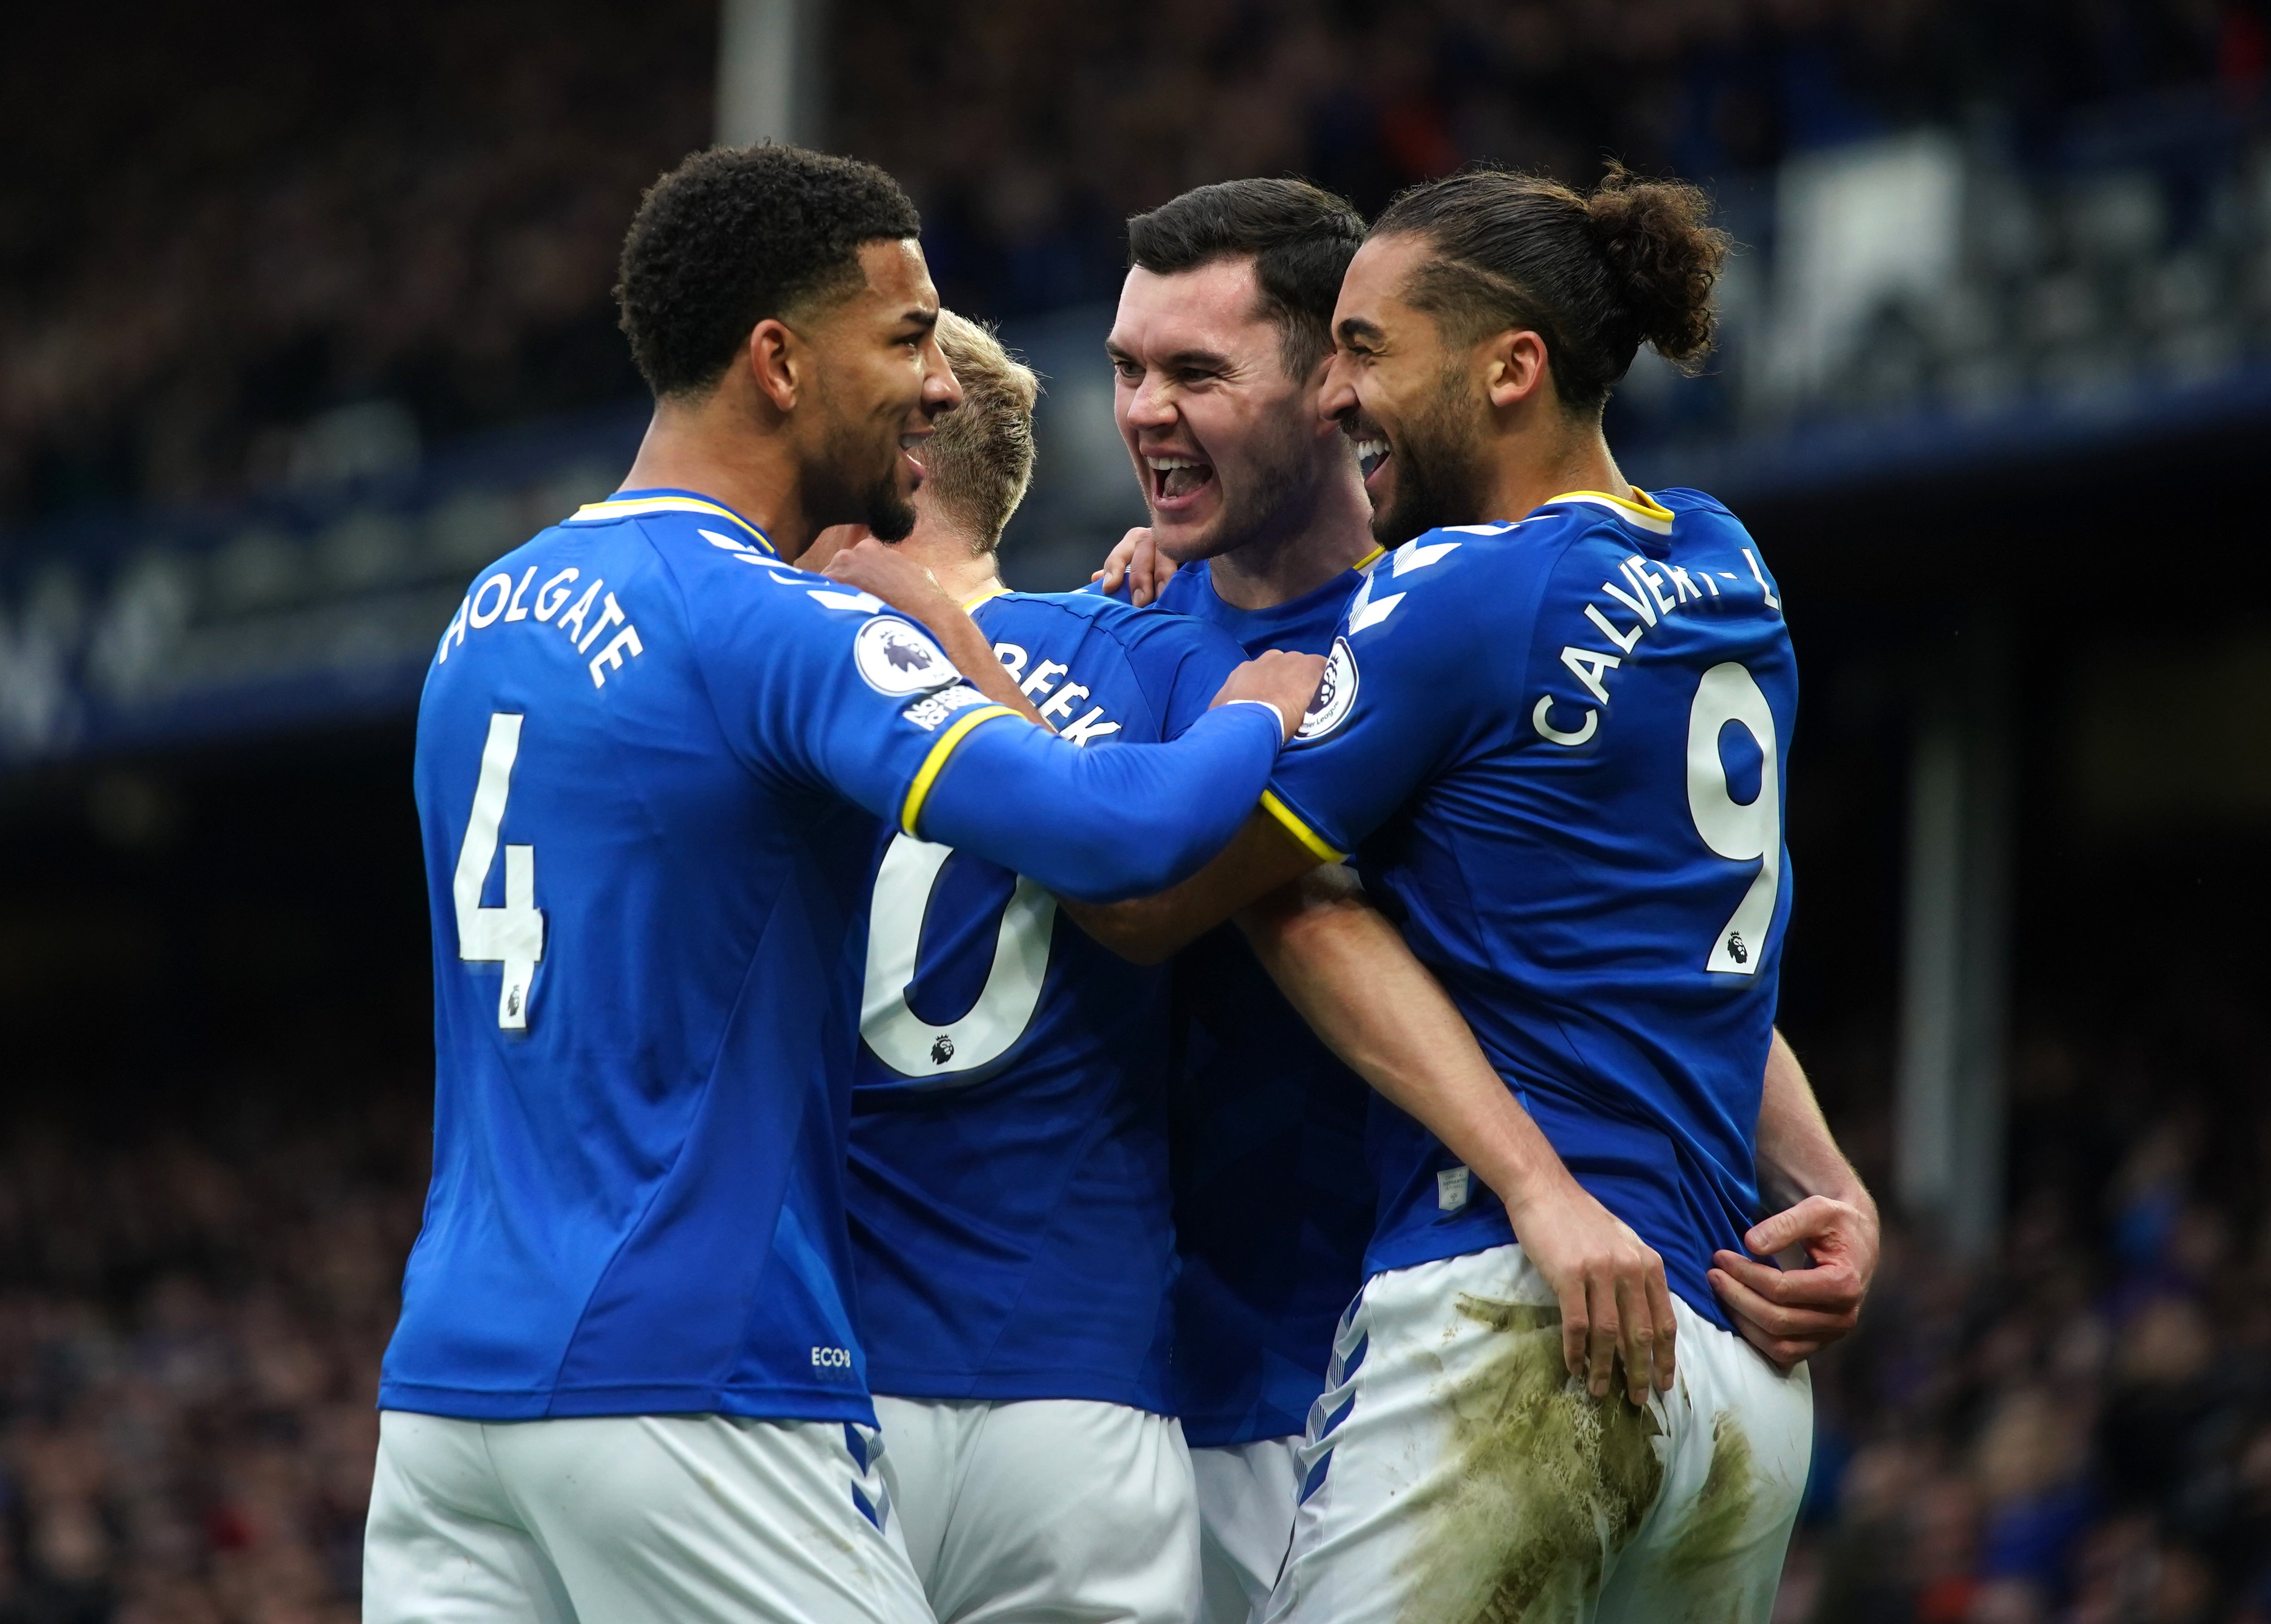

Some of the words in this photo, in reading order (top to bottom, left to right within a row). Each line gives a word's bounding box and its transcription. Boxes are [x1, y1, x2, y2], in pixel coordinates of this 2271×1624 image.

[438, 565, 643, 689] HOLGATE
[1316, 700, 1340, 725] League
[453, 713, 544, 1029] 4
[1686, 661, 1781, 975] 9
